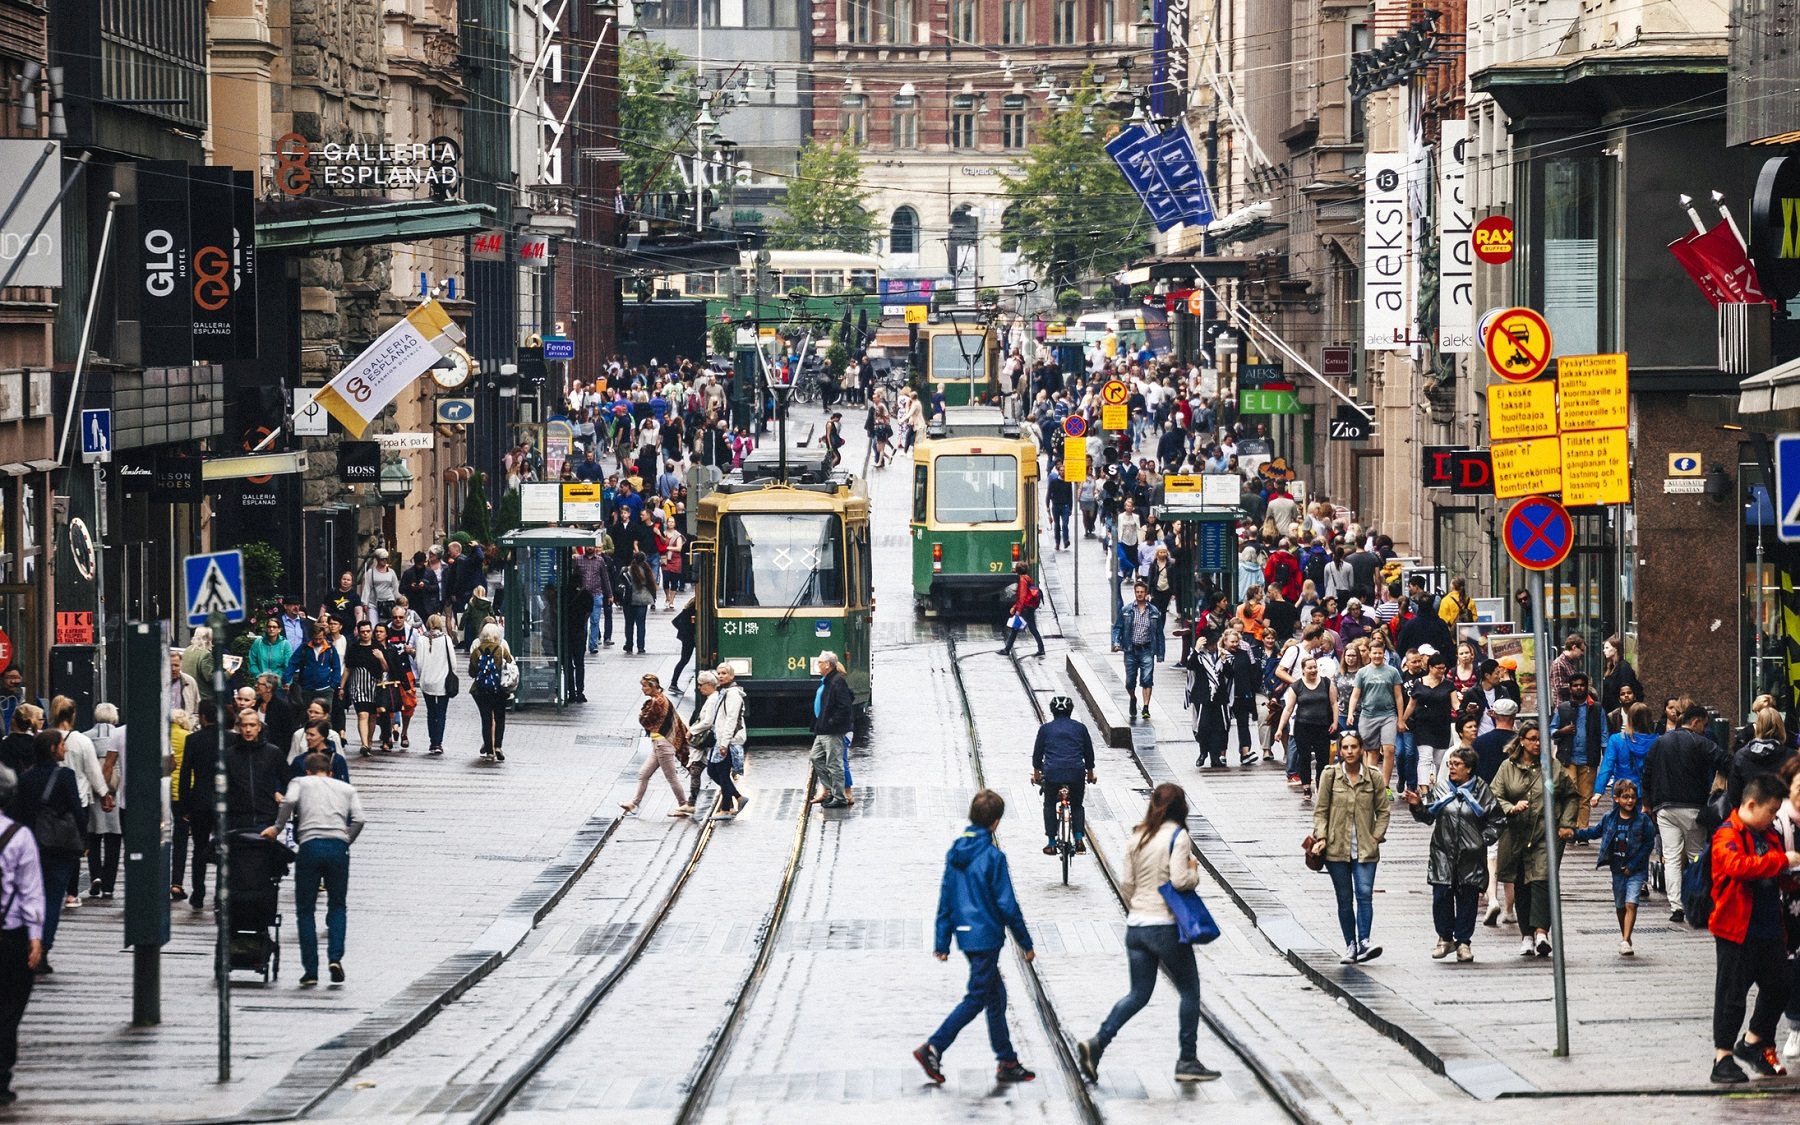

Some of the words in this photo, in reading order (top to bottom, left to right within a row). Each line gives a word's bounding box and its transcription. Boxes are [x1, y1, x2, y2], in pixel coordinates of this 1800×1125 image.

[324, 142, 456, 161] GALLERIA
[324, 166, 458, 184] ESPLANAD
[1476, 228, 1513, 244] RAX
[144, 229, 174, 297] GLO
[1368, 199, 1403, 312] aleksi
[362, 334, 412, 376] GALLERIA
[368, 339, 418, 382] ESPLANAD
[1497, 390, 1504, 399] Ei
[1508, 388, 1532, 397] koske
[1332, 421, 1360, 438] Zio
[347, 466, 376, 474] BOSS
[1460, 459, 1489, 488] D
[990, 562, 1004, 573] 97
[787, 656, 807, 671] 84
